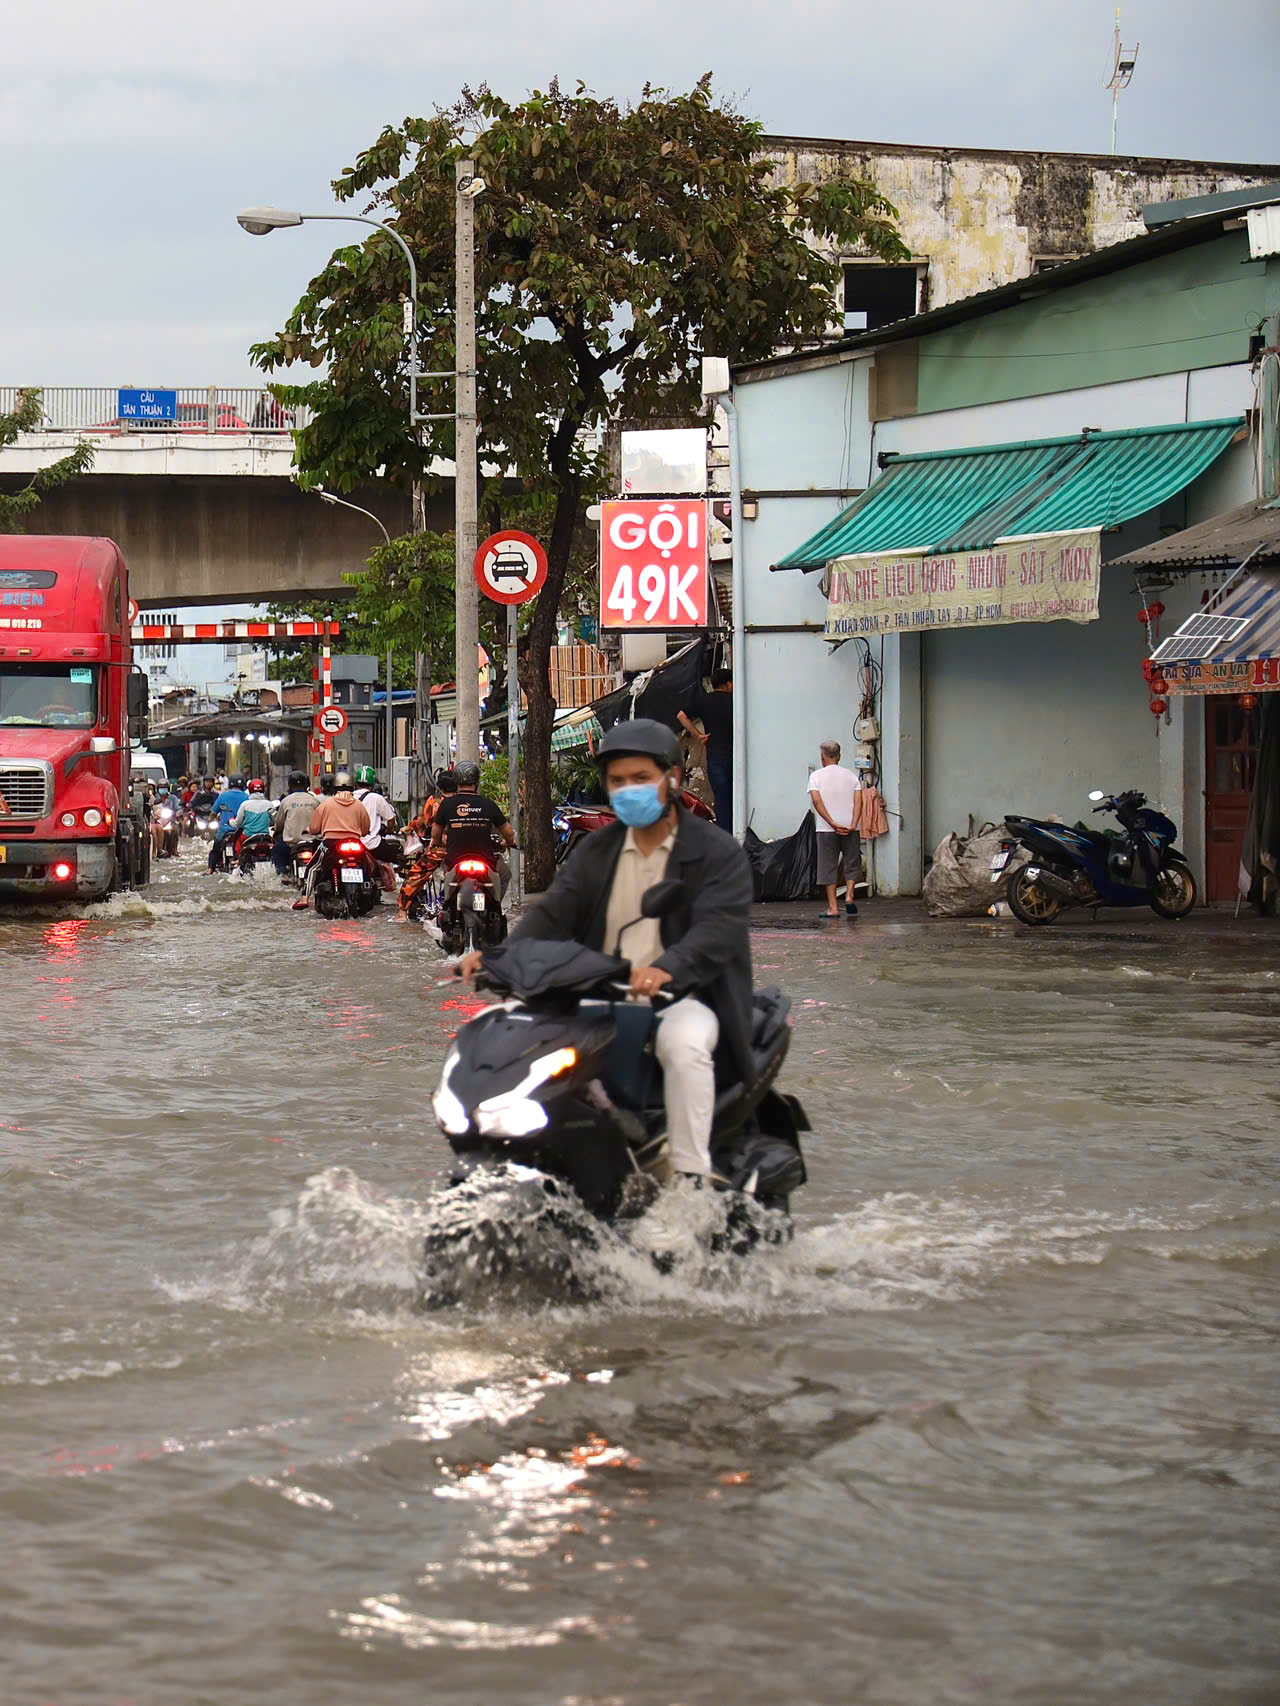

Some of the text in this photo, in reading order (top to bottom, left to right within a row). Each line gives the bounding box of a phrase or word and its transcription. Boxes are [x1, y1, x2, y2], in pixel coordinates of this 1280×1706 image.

[166, 405, 171, 416] 2
[609, 503, 698, 558] GỘI
[1059, 546, 1092, 583] INOX
[607, 564, 699, 621] 49K
